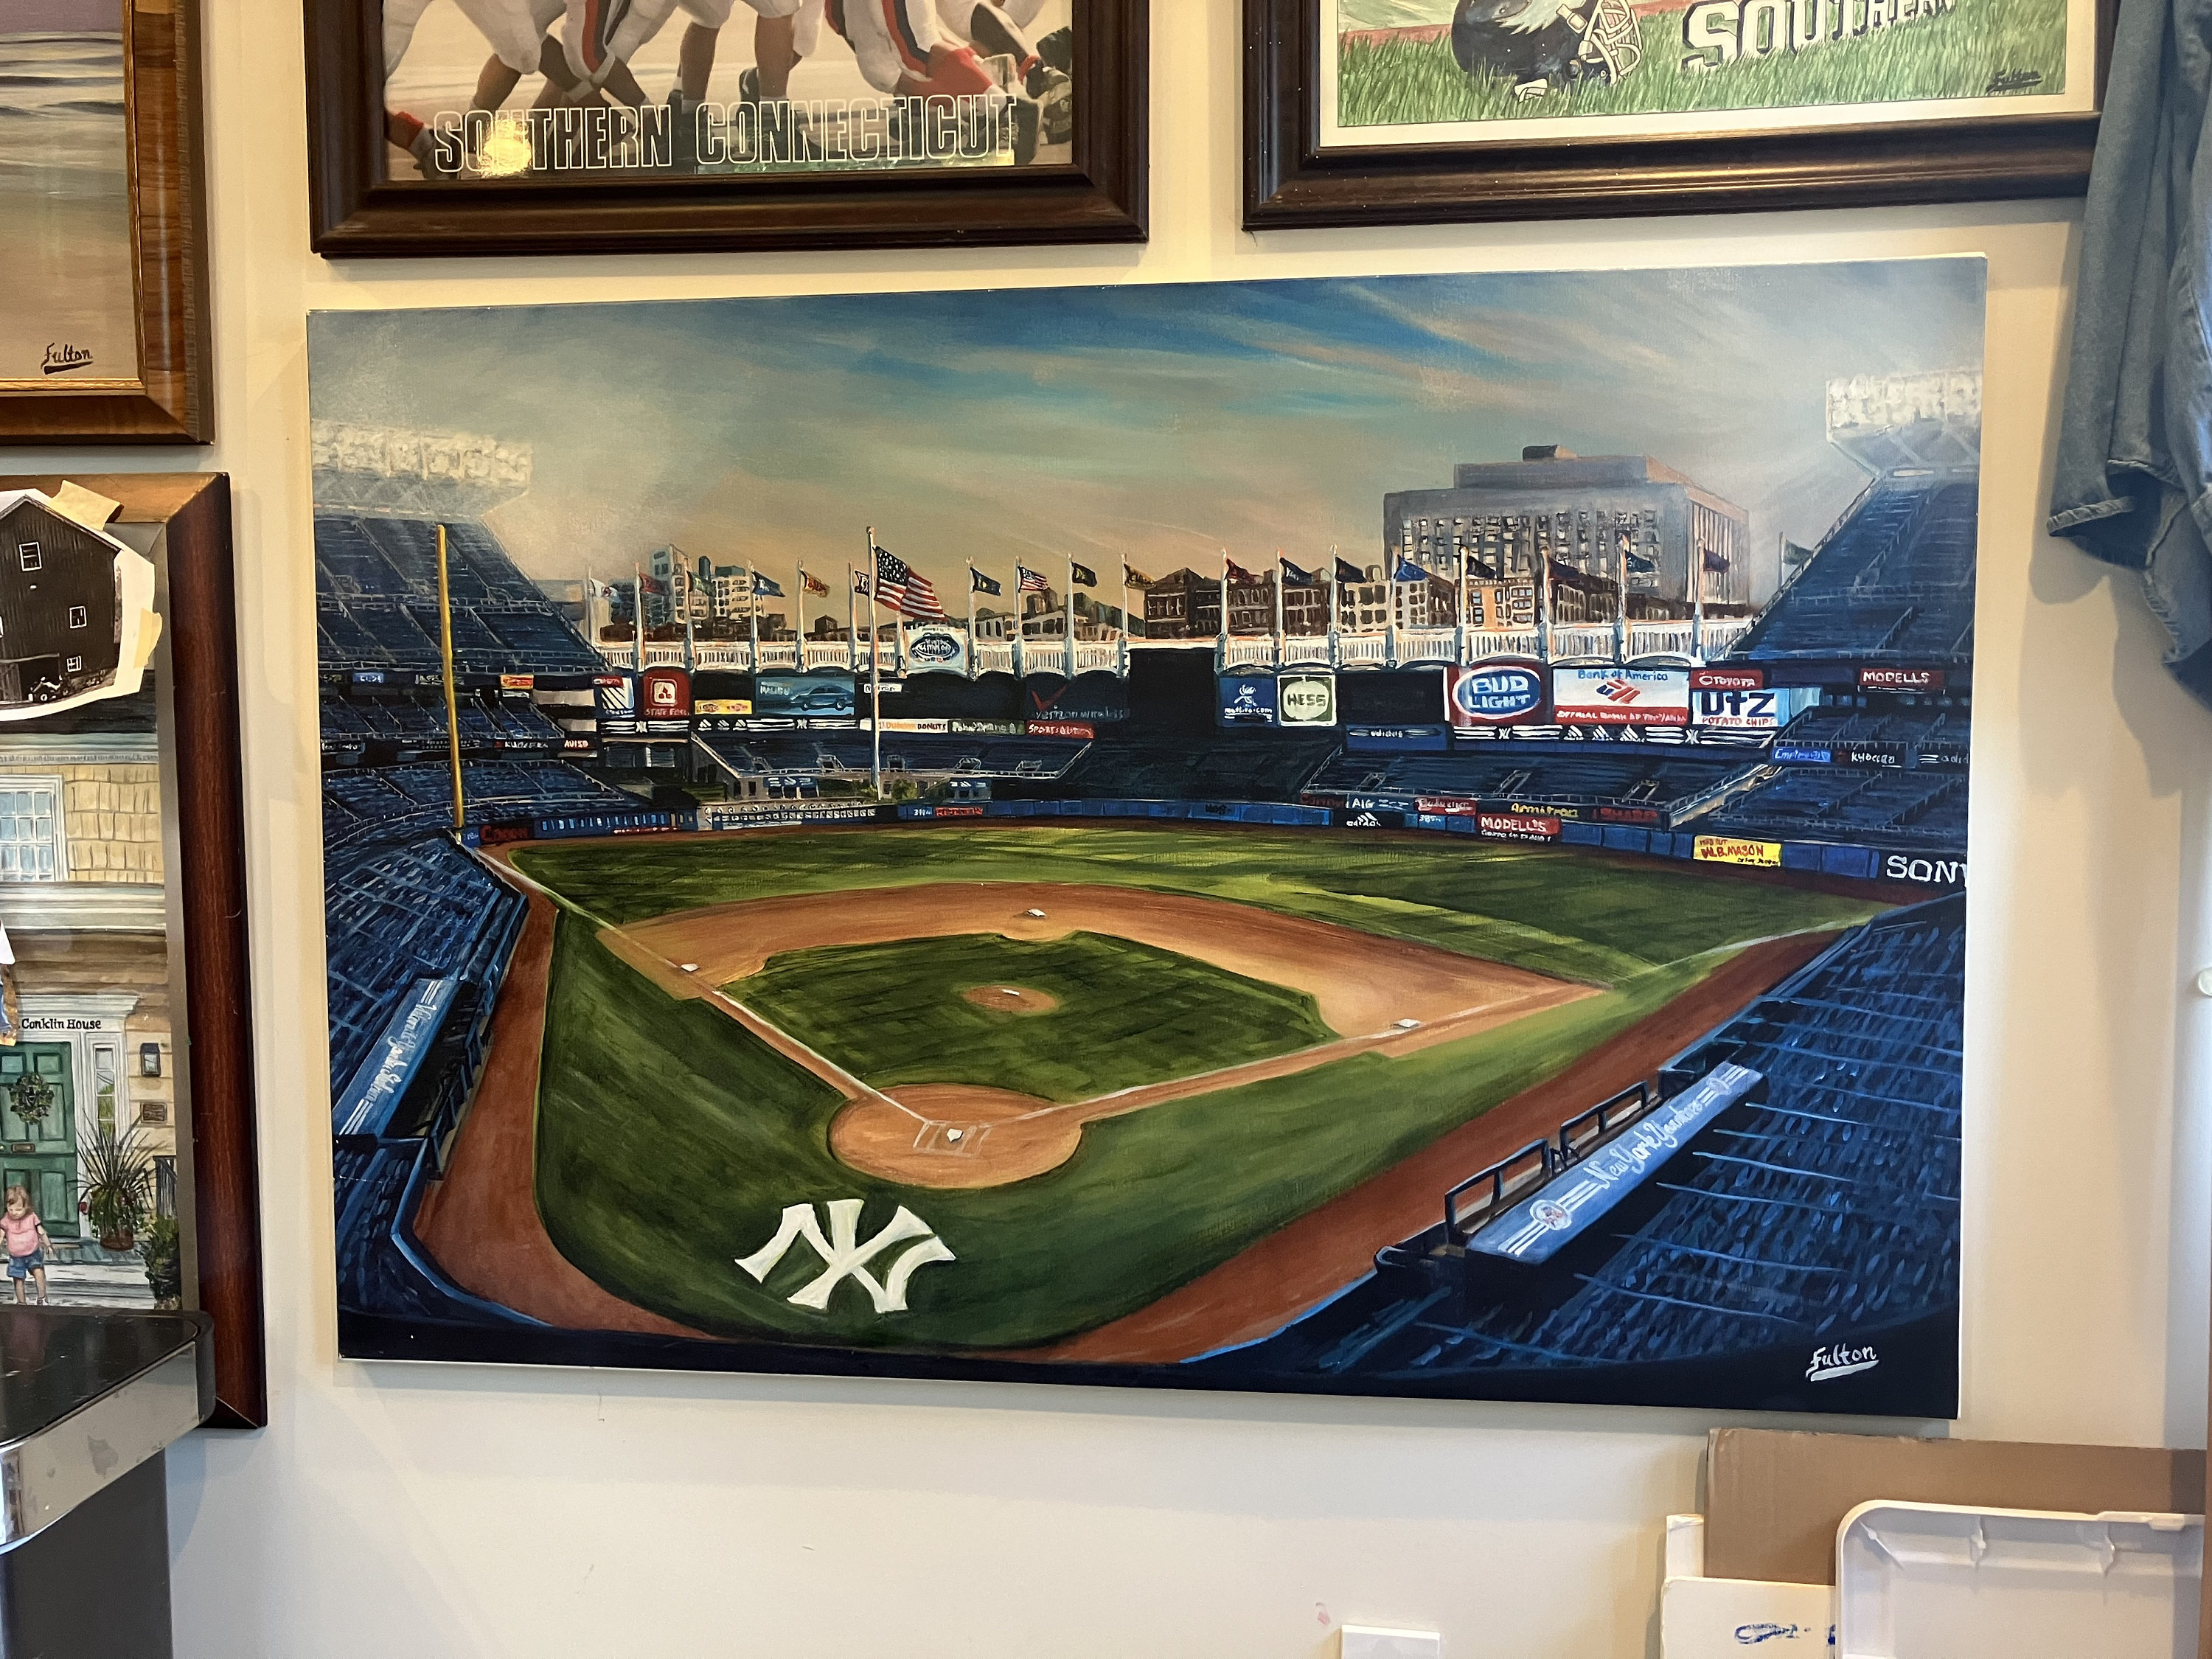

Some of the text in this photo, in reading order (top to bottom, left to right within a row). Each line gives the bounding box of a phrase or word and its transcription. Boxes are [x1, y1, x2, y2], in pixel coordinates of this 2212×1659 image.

[695, 94, 1018, 166] CONNECTICUT
[40, 342, 94, 370] Fulton
[1577, 669, 1669, 681] Bank of America
[1471, 675, 1528, 694] BUD
[1287, 693, 1326, 707] HESS
[1467, 694, 1531, 709] LIGHT
[917, 723, 947, 731] DONUTS
[1702, 716, 1775, 727] POTATO CHIPS
[1352, 798, 1374, 809] AIG
[1481, 816, 1547, 832] MODELL'S
[21, 1018, 102, 1030] Conklin House
[1805, 1343, 1877, 1378] Fulton
